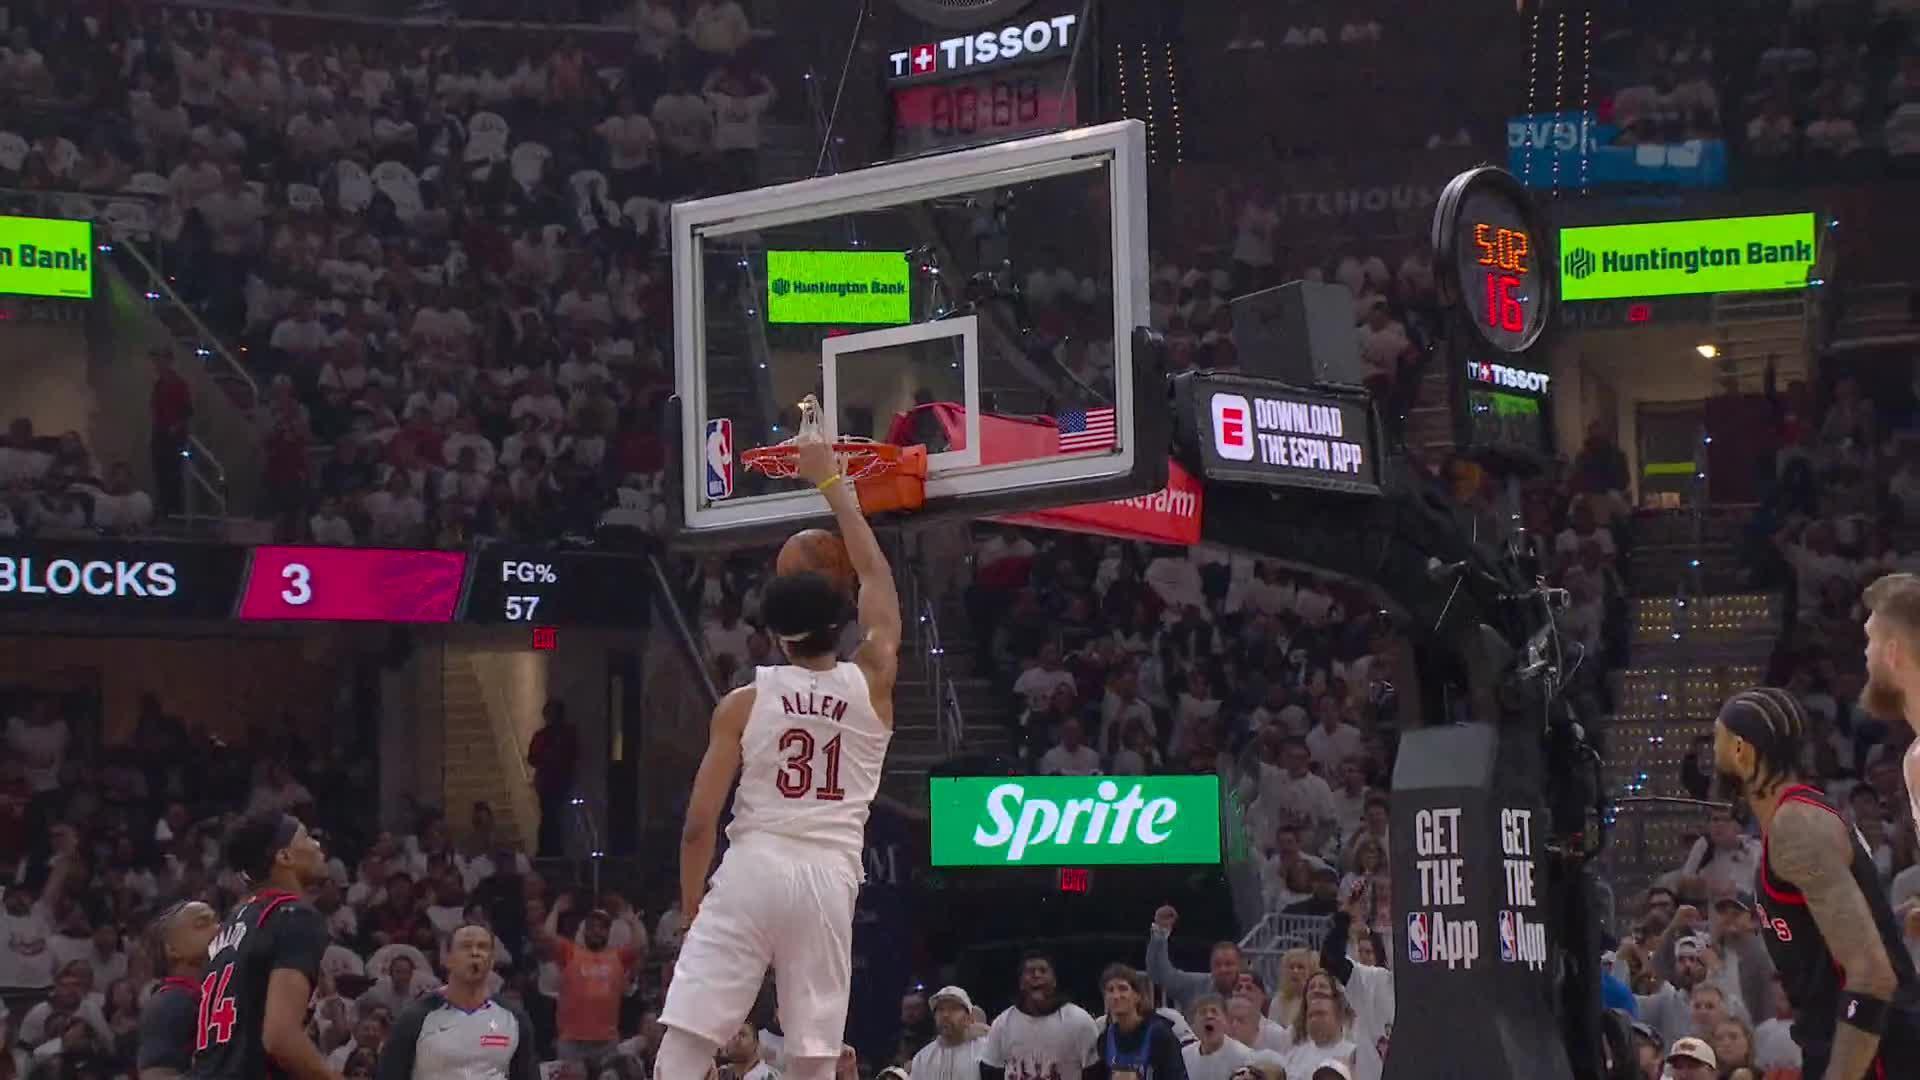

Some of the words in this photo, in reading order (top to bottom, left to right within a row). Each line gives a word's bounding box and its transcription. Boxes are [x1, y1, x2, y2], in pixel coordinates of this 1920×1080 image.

[940, 14, 1076, 69] TISSOT
[19, 244, 87, 272] Bank
[1474, 223, 1529, 274] 5:02
[1602, 246, 1741, 275] Huntington
[1747, 240, 1812, 265] Bank
[793, 280, 869, 297] Huntington
[871, 280, 905, 295] Bank
[1487, 272, 1524, 332] 16
[1491, 365, 1550, 394] TISSOT
[1254, 398, 1343, 437] DOWNLOAD
[1258, 434, 1289, 466] THE
[1289, 437, 1331, 470] ESPN
[1331, 442, 1363, 474] APP
[281, 563, 312, 605] 3
[502, 561, 557, 583] FG%
[506, 596, 540, 620] 57
[781, 692, 848, 722] ALLEN
[776, 728, 845, 800] 31
[973, 780, 1178, 861] Sprite
[1416, 808, 1461, 856] GET
[1501, 808, 1531, 856] GET
[1416, 859, 1465, 906] THE
[1503, 859, 1536, 906] THE
[1431, 911, 1479, 969] App
[1515, 911, 1546, 971] App
[197, 962, 237, 1049] 14
